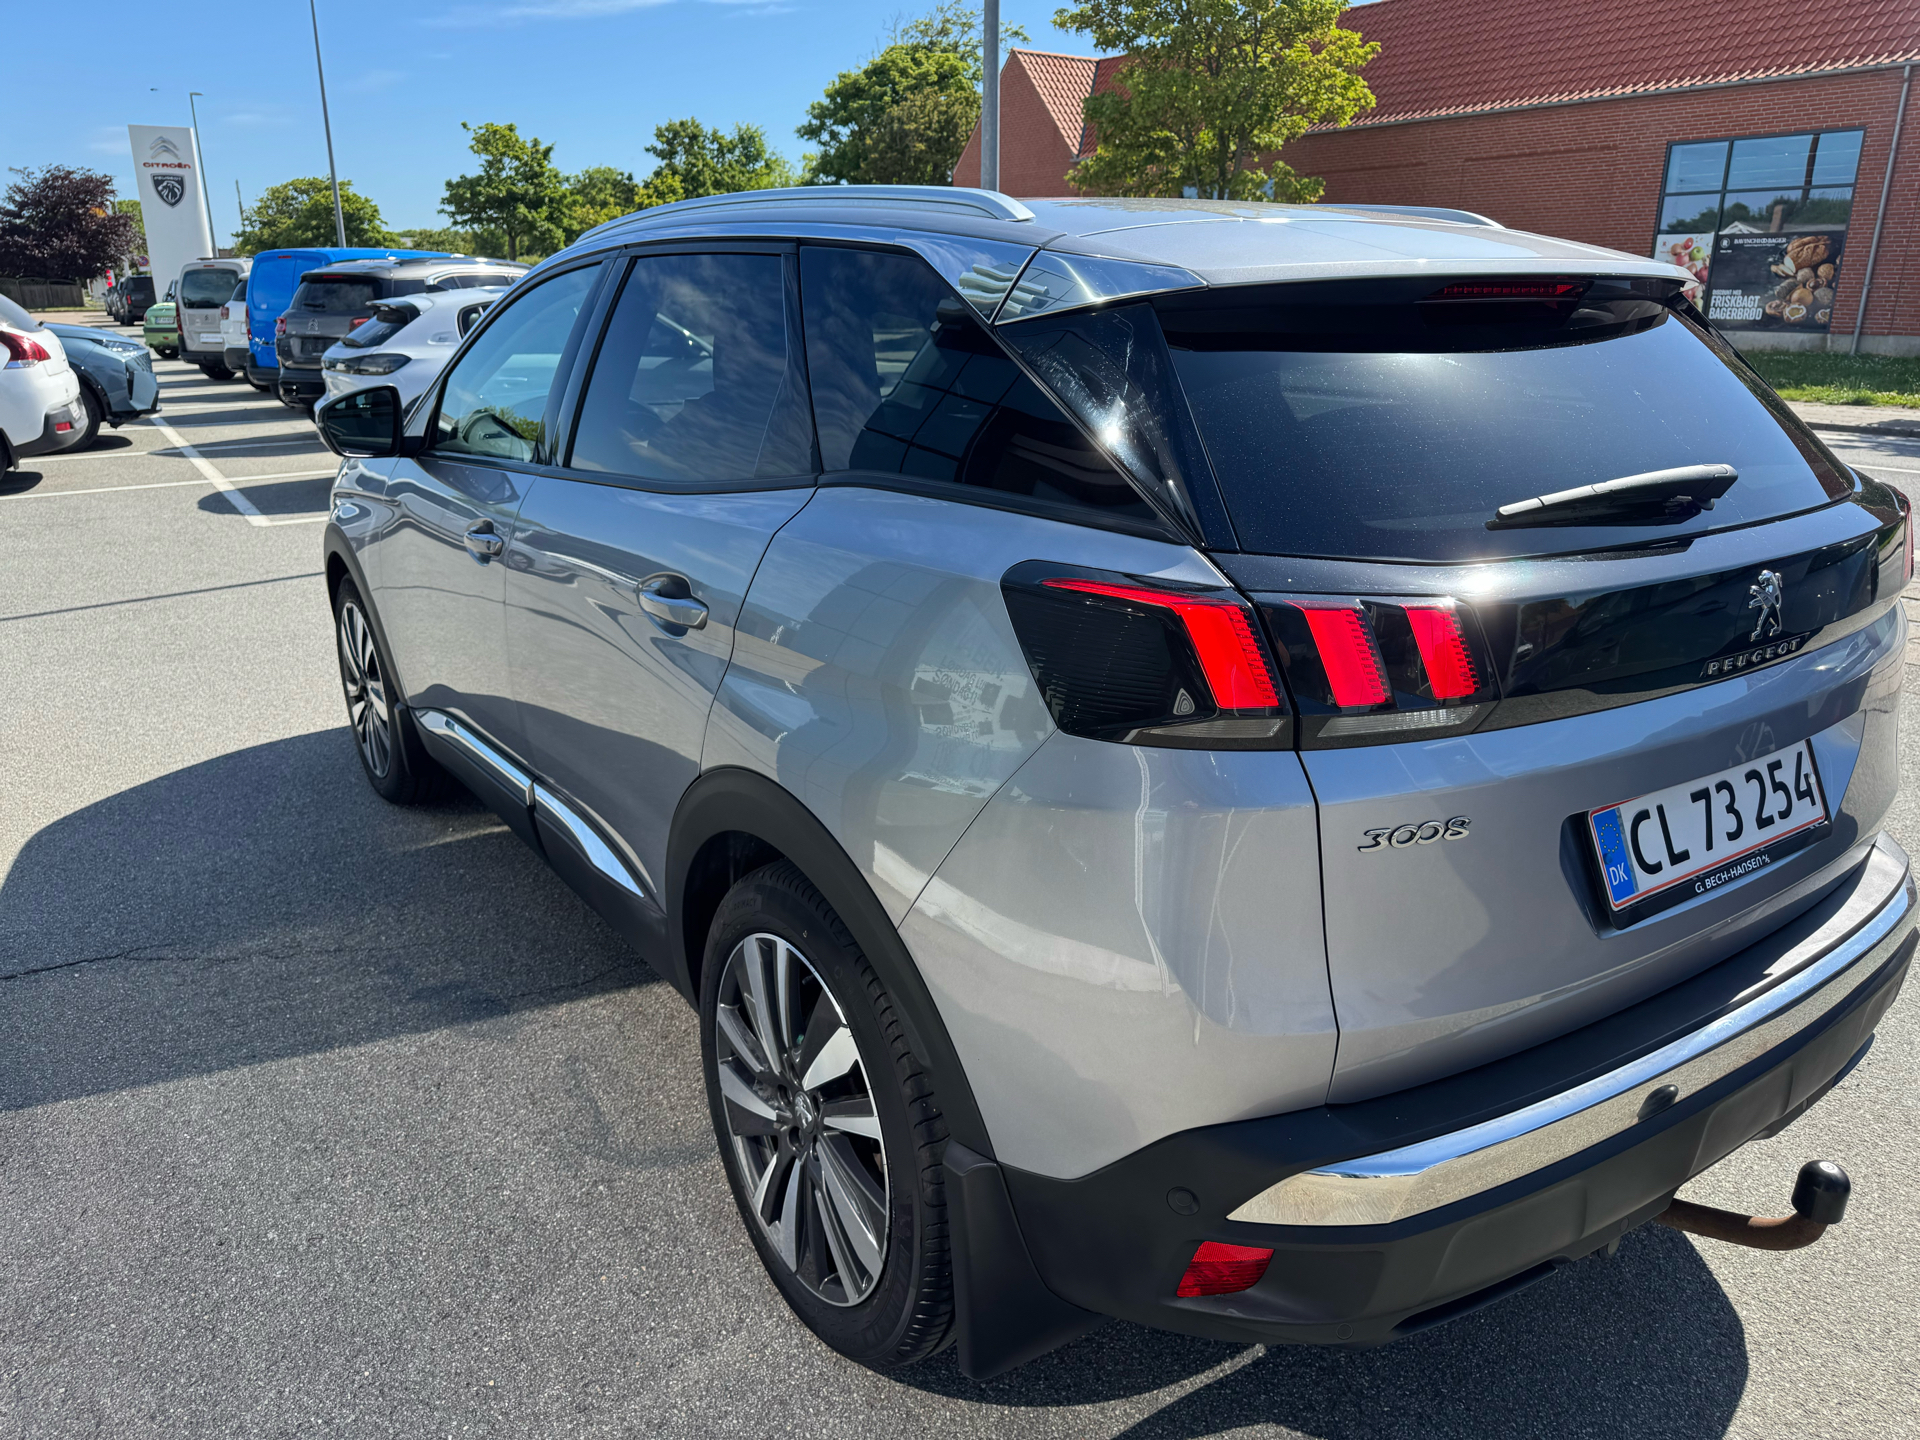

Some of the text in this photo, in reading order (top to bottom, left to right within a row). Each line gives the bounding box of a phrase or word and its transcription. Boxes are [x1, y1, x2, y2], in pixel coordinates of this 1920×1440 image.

[1708, 307, 1763, 320] BAGERBRØD
[1711, 295, 1761, 308] FRISKBAGT
[1707, 638, 1801, 675] PEUGEOT
[1630, 750, 1817, 875] CL 73 254
[1357, 815, 1473, 854] 3008
[1608, 863, 1629, 886] DK
[1694, 881, 1705, 894] G.
[1705, 856, 1763, 892] BECH-HANSEN
